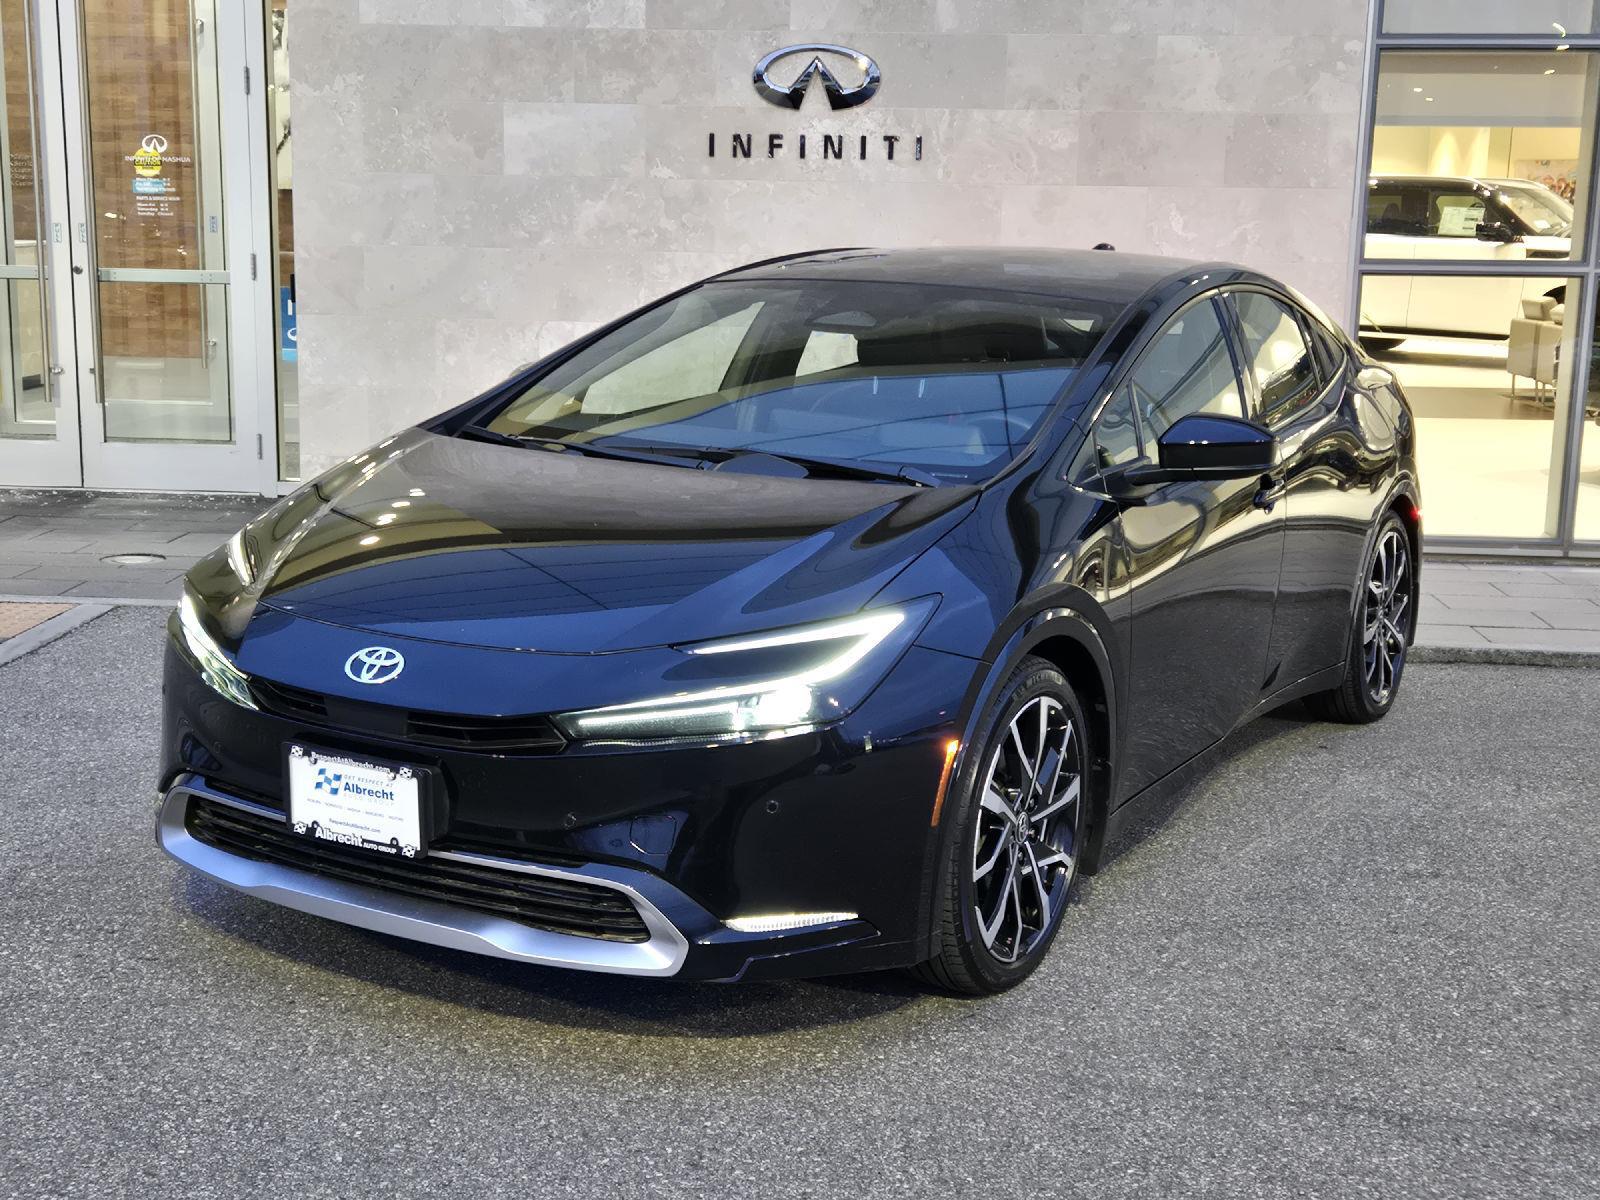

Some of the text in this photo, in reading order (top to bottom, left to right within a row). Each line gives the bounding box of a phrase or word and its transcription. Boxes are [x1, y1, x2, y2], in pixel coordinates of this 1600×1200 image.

[708, 132, 923, 161] INFINITI
[343, 781, 395, 801] Albrecht
[315, 826, 397, 854] Albrecht AUTO GROUP
